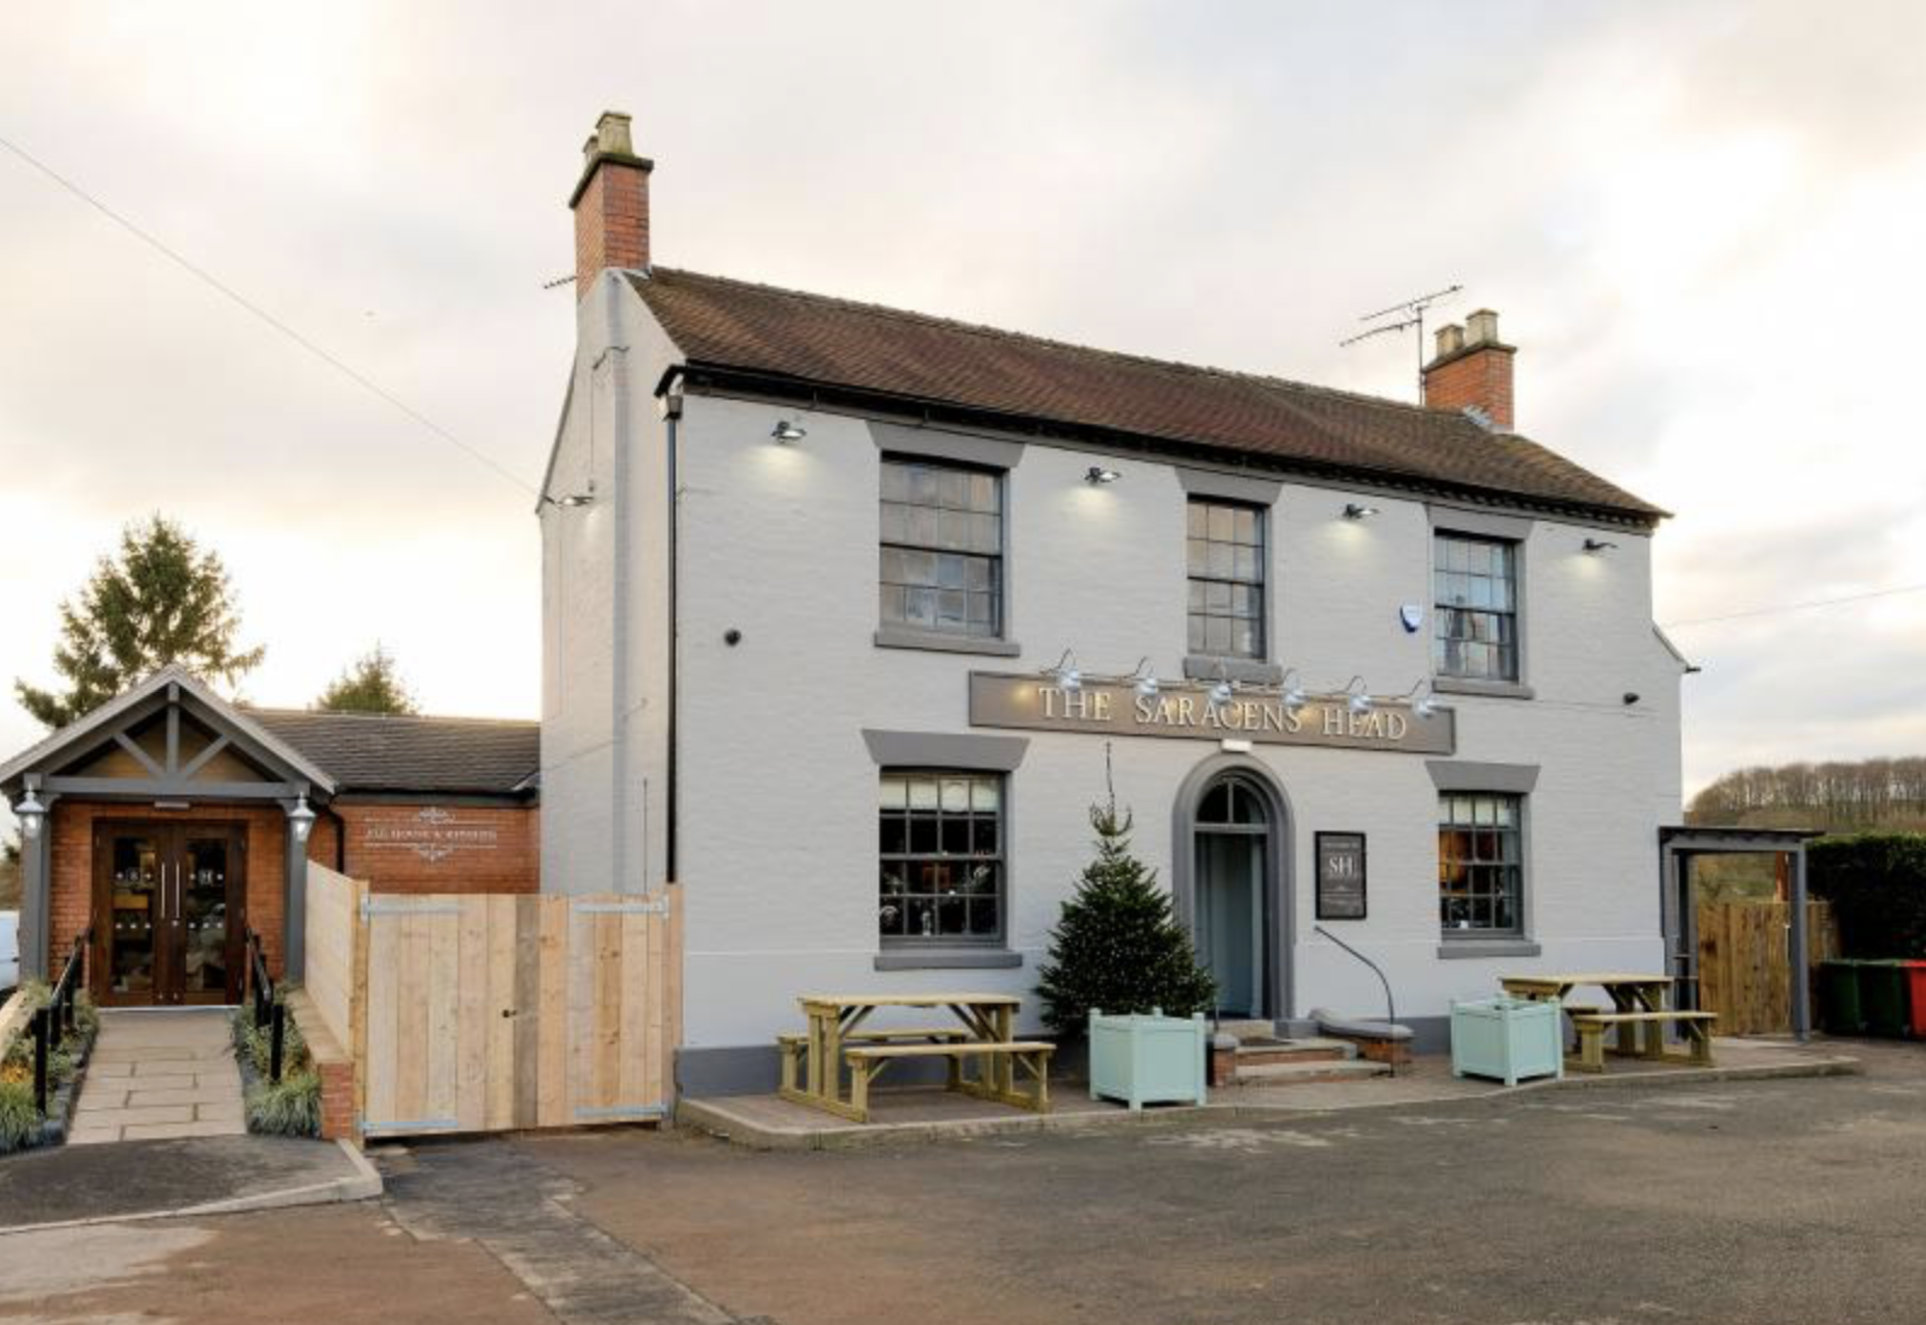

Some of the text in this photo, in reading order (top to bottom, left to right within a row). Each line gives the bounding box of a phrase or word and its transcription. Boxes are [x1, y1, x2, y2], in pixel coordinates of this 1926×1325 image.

[1039, 687, 1407, 740] THE SARACENS HEAD
